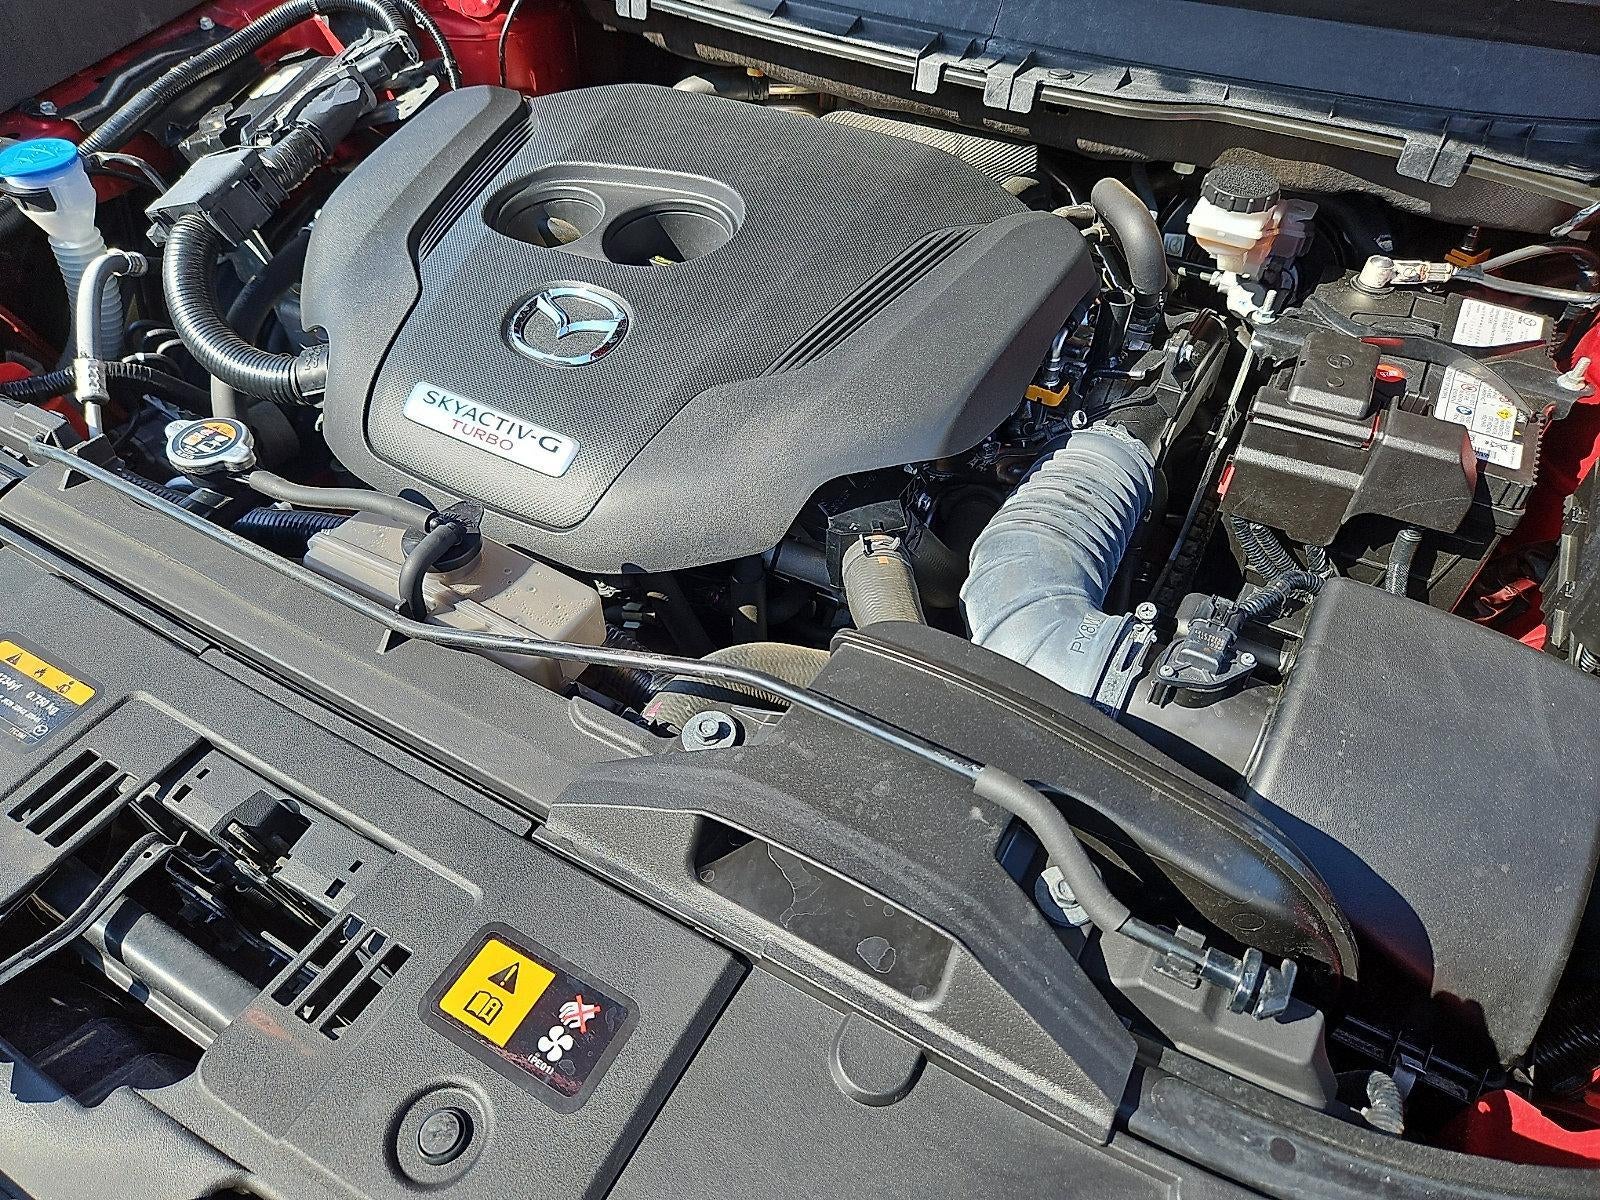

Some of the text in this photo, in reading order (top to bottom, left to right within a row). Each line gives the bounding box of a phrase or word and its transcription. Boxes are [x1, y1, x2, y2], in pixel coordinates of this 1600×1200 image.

[423, 390, 562, 453] SKYACTIV-G
[452, 418, 514, 451] TURBO
[528, 1053, 555, 1075] (PE01)
